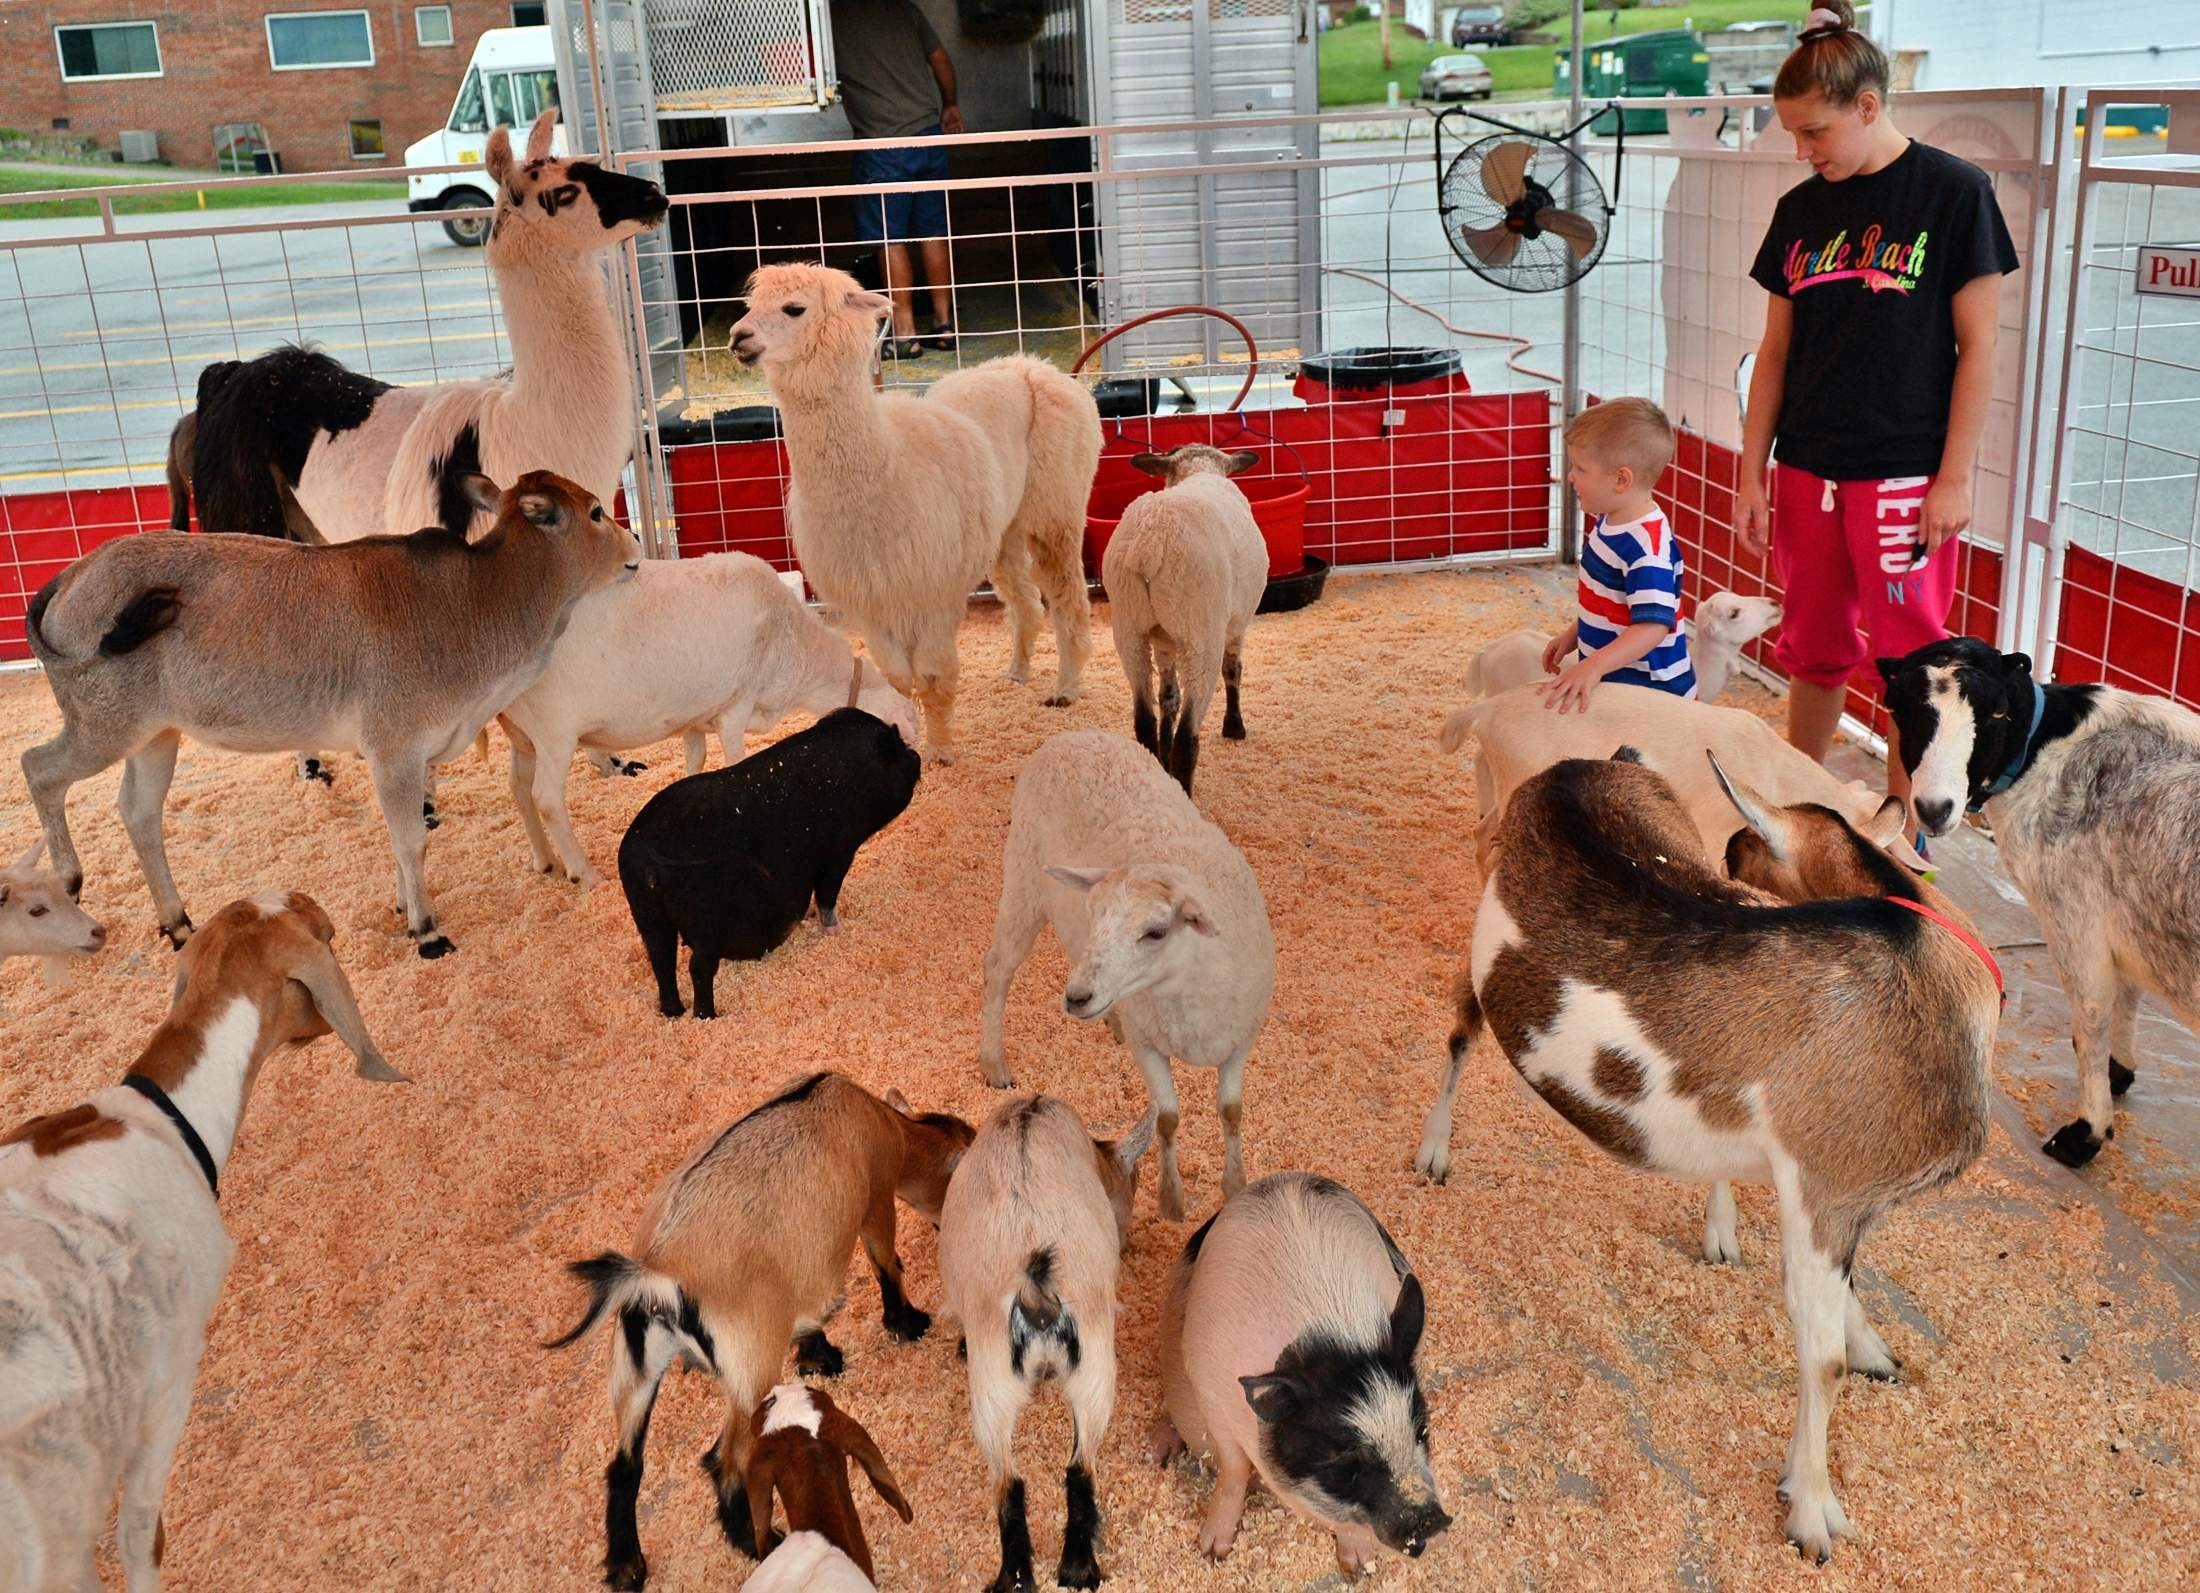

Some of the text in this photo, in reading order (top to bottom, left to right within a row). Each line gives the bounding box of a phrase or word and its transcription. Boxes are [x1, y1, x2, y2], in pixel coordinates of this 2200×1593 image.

[1855, 224, 1928, 277] Beach
[2148, 255, 2200, 288] Pul
[1887, 576, 1925, 605] NY
